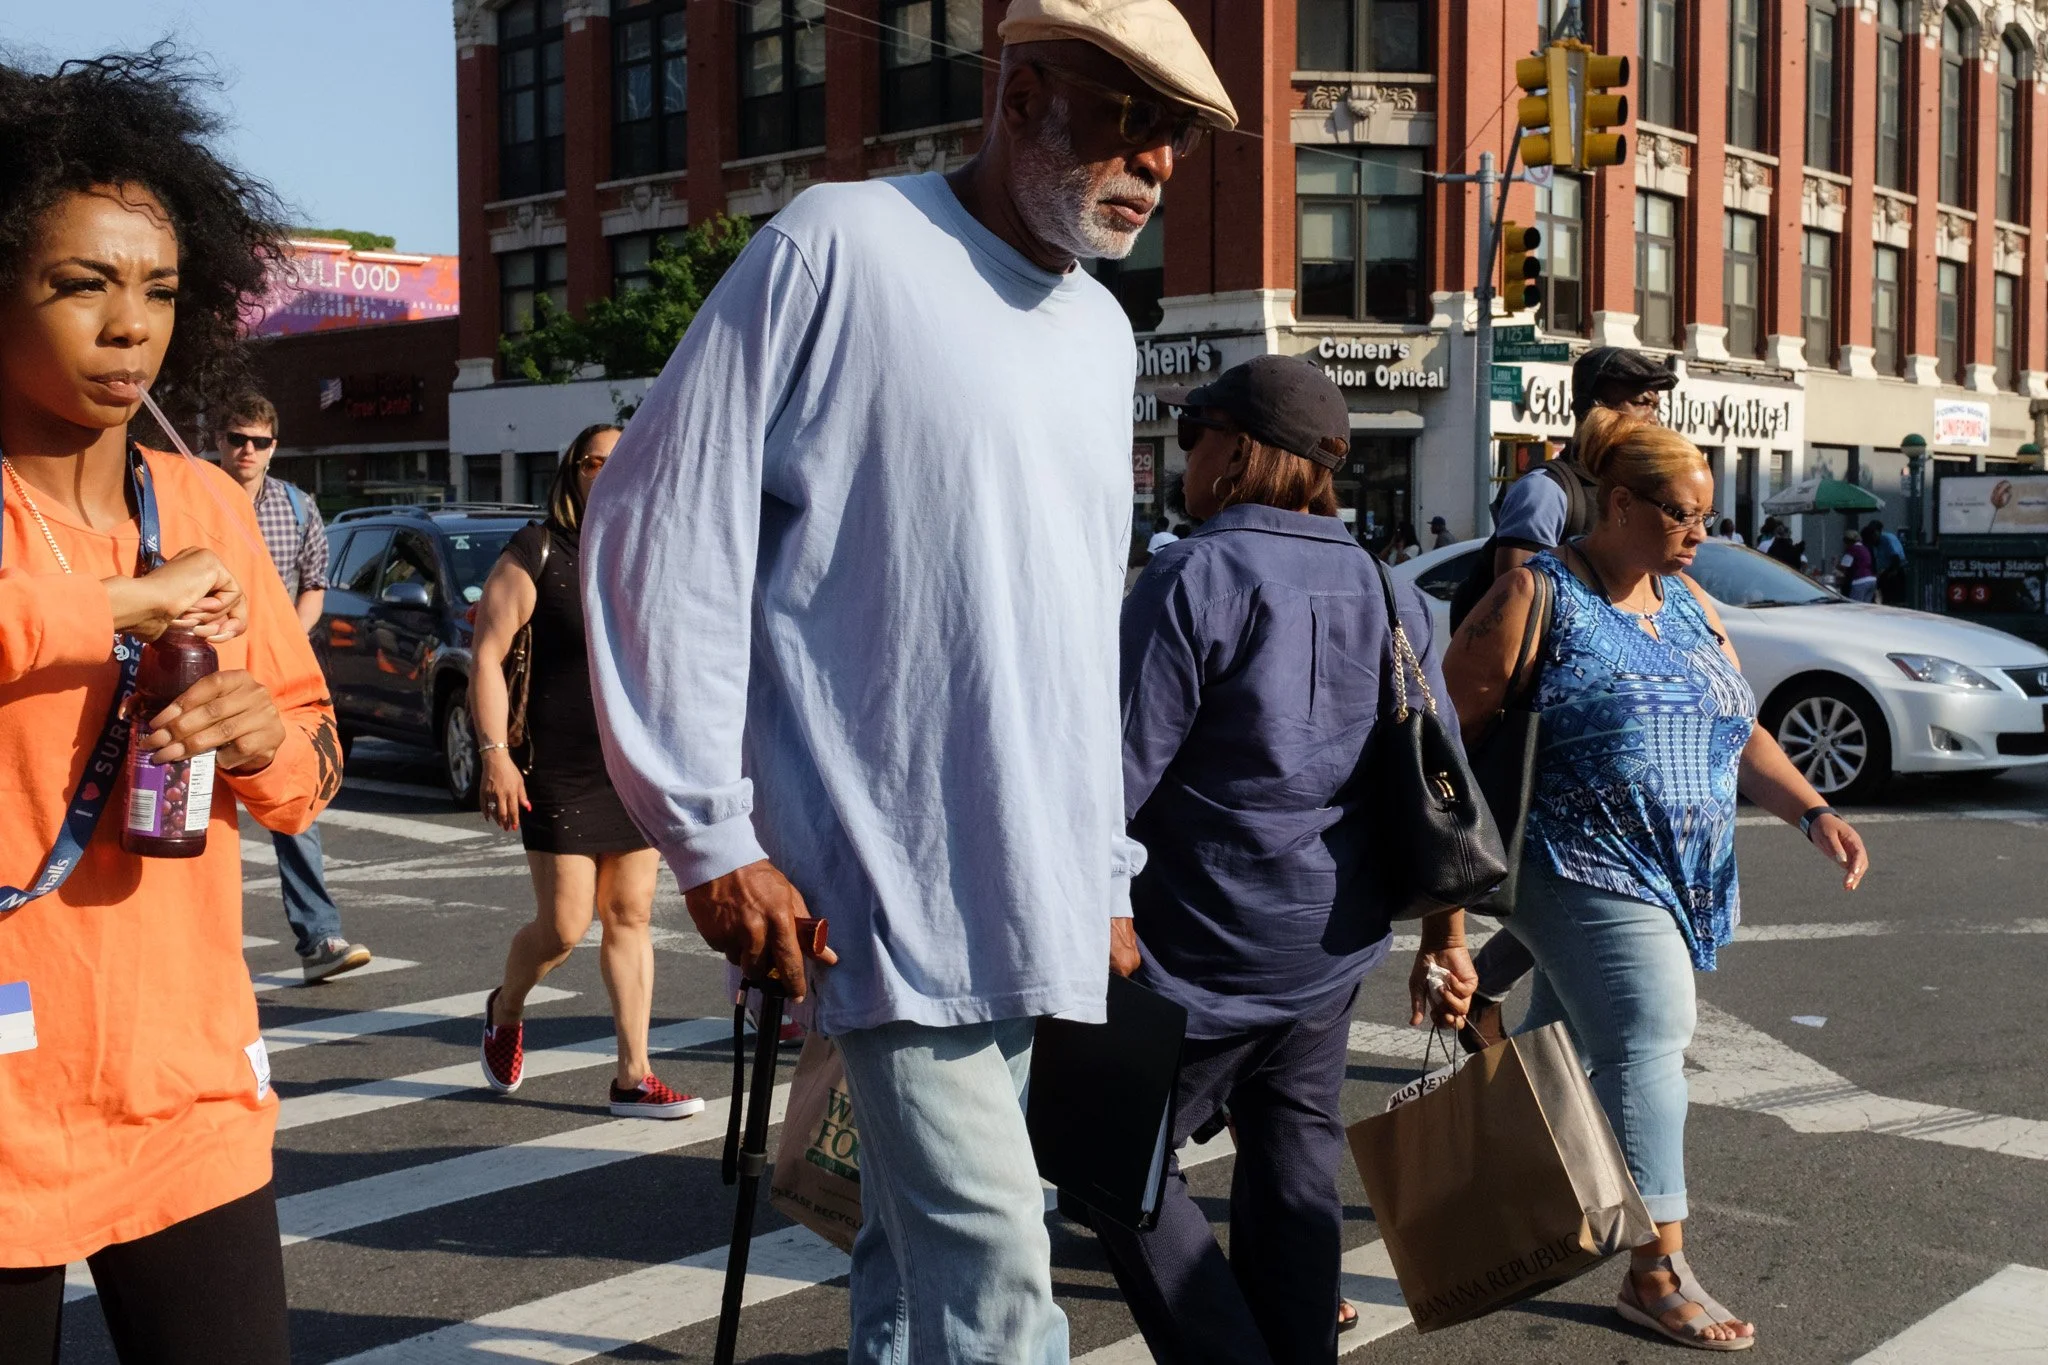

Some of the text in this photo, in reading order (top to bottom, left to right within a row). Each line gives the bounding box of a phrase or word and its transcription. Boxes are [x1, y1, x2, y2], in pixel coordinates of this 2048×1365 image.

[1506, 328, 1523, 341] 125
[1319, 337, 1410, 359] Cohen's
[1375, 365, 1445, 390] Optical
[1724, 395, 1791, 437] Optical
[1948, 560, 2044, 571] 125 Street Station
[1953, 587, 1985, 600] 2 3
[1414, 1232, 1583, 1322] BANANA REPUBLIC
